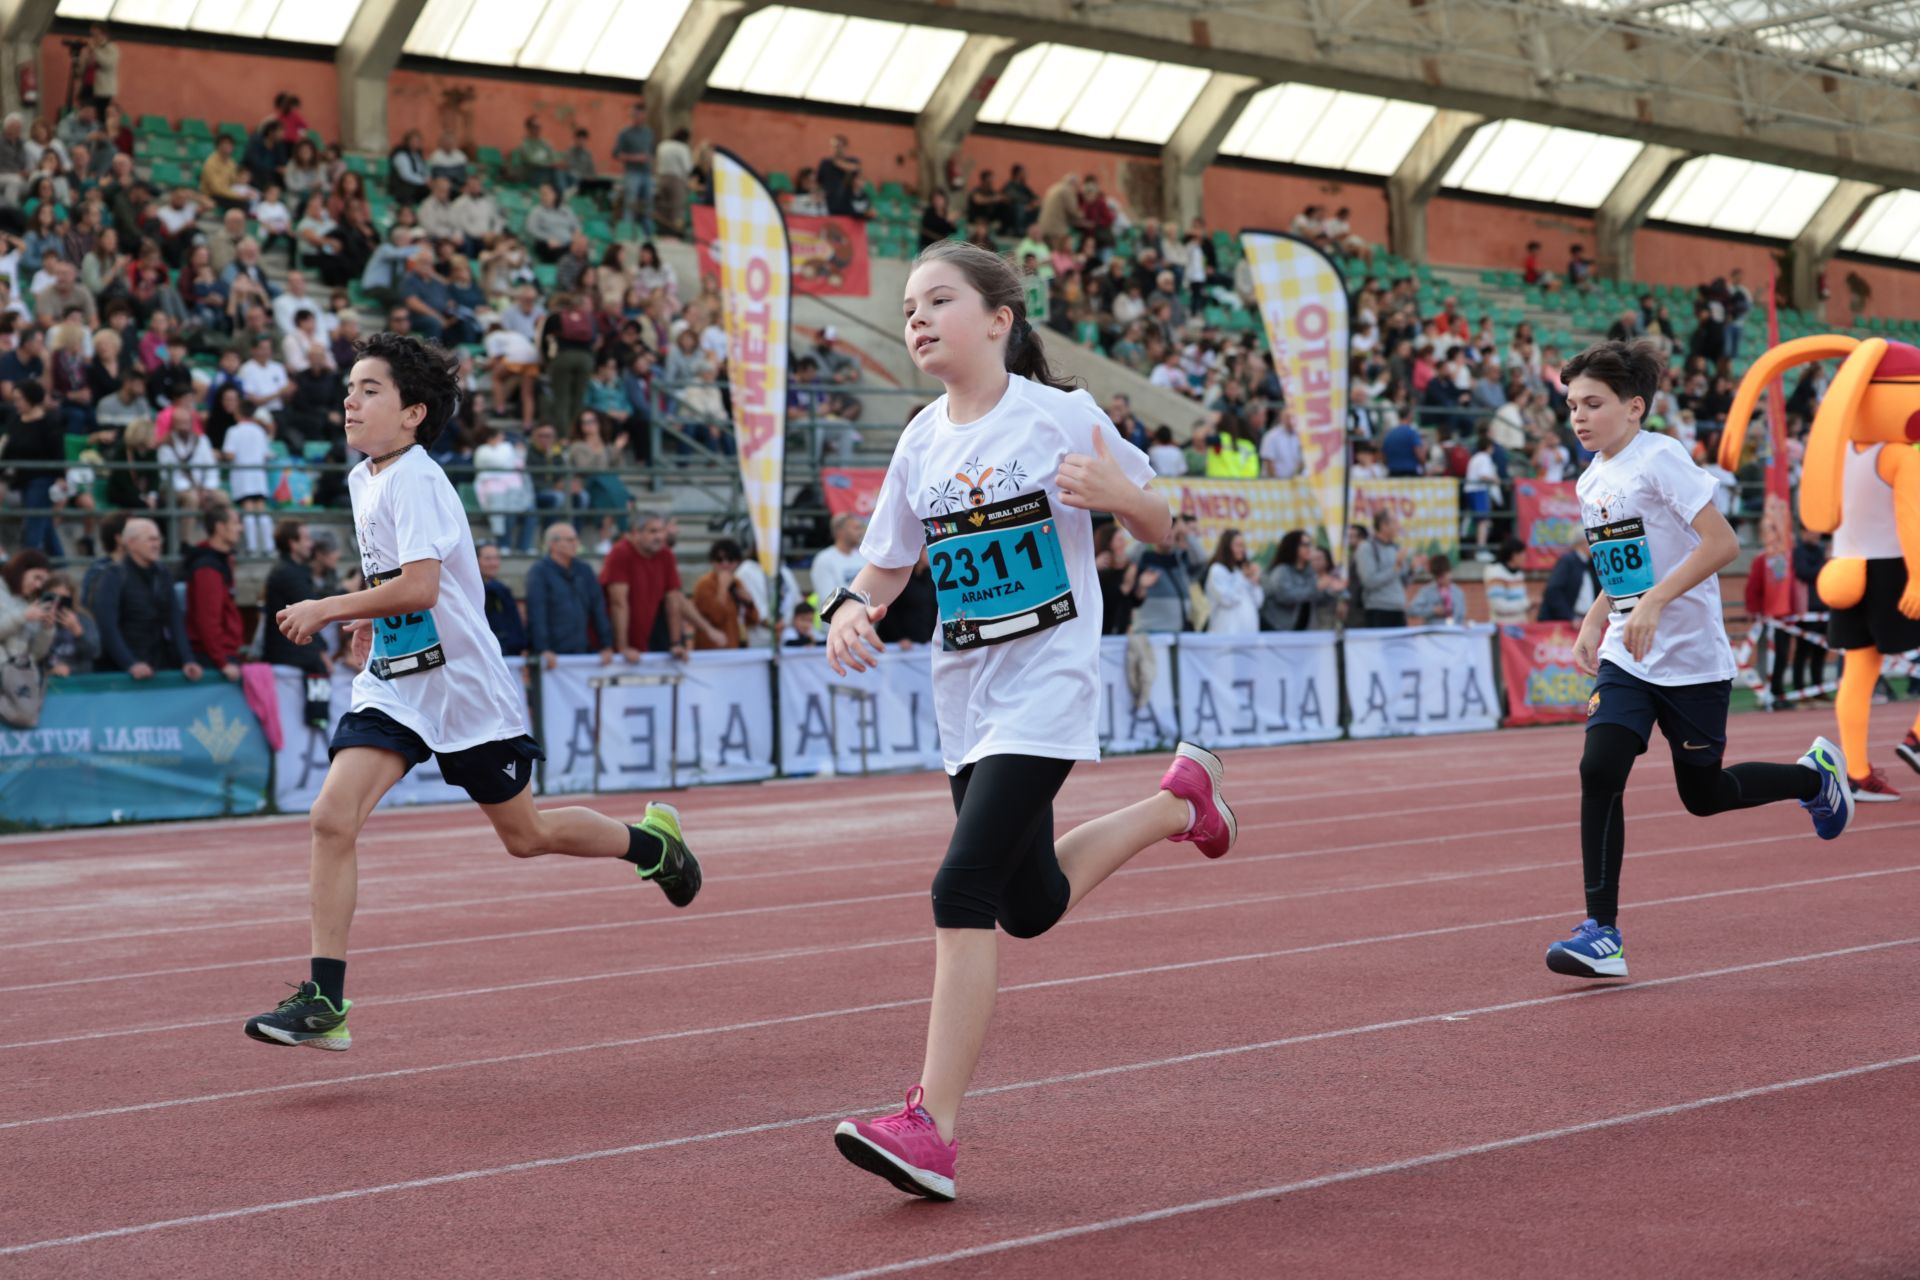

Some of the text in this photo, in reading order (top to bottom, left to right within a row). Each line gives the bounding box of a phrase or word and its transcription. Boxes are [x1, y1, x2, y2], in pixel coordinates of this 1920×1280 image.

[988, 508, 1013, 520] RURAL
[1013, 502, 1040, 514] KUTXA
[933, 531, 1043, 591] 2311
[1593, 545, 1643, 576] 2368
[962, 581, 1025, 604] ARANTZA
